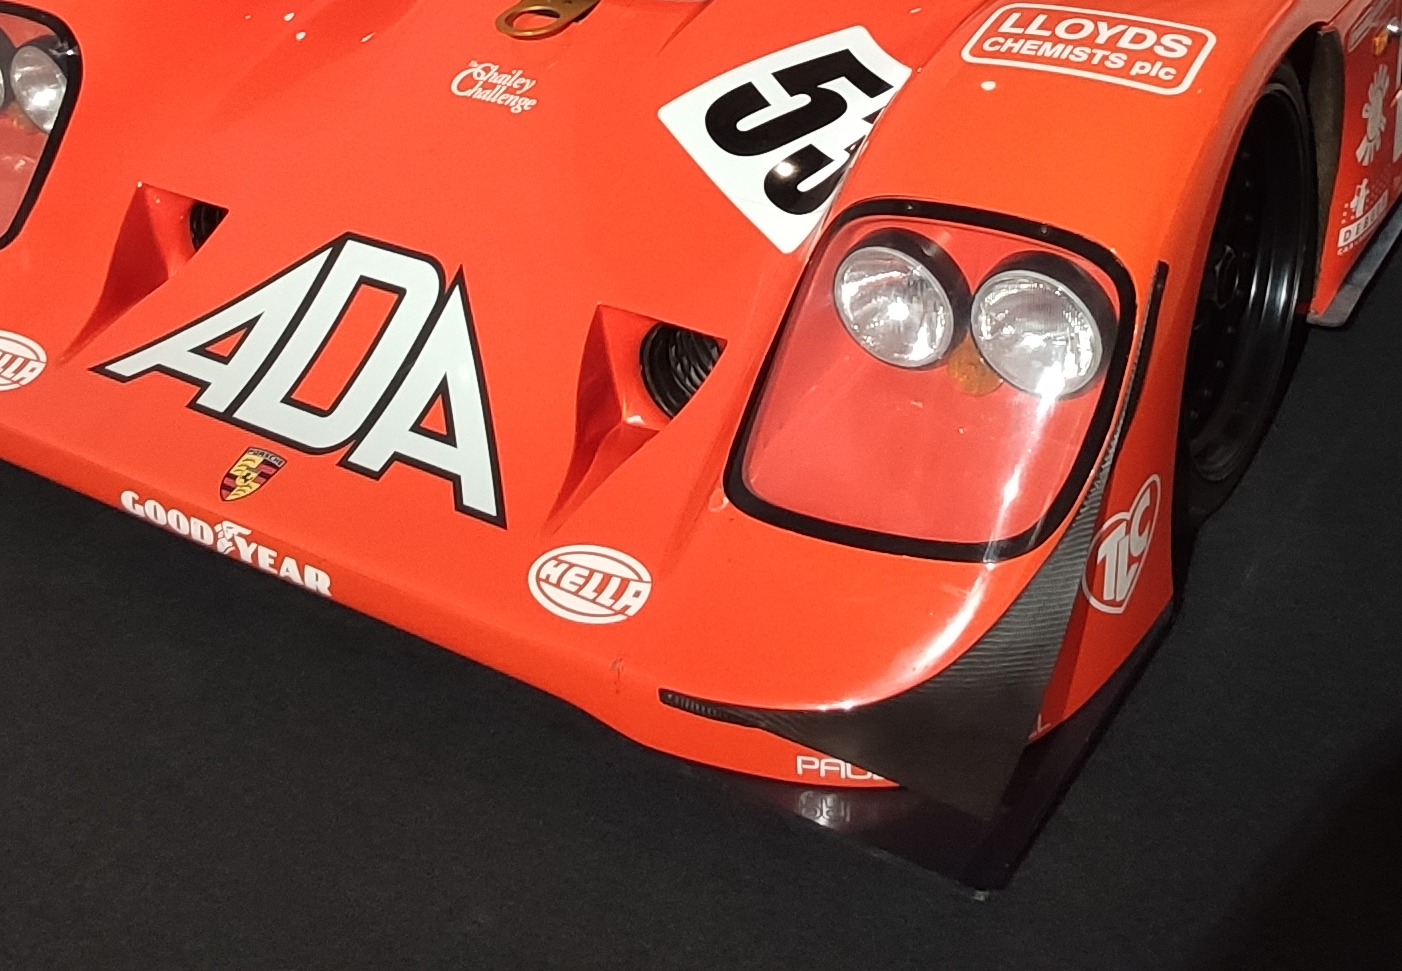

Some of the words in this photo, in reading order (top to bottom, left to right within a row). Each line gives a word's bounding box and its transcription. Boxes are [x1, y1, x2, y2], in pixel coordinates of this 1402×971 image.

[982, 36, 1128, 70] CHEMISTS
[1130, 59, 1177, 81] plc
[996, 11, 1193, 59] LLOYDS
[451, 68, 537, 114] Challenge
[88, 231, 507, 529] ADA
[538, 557, 652, 618] HELLA
